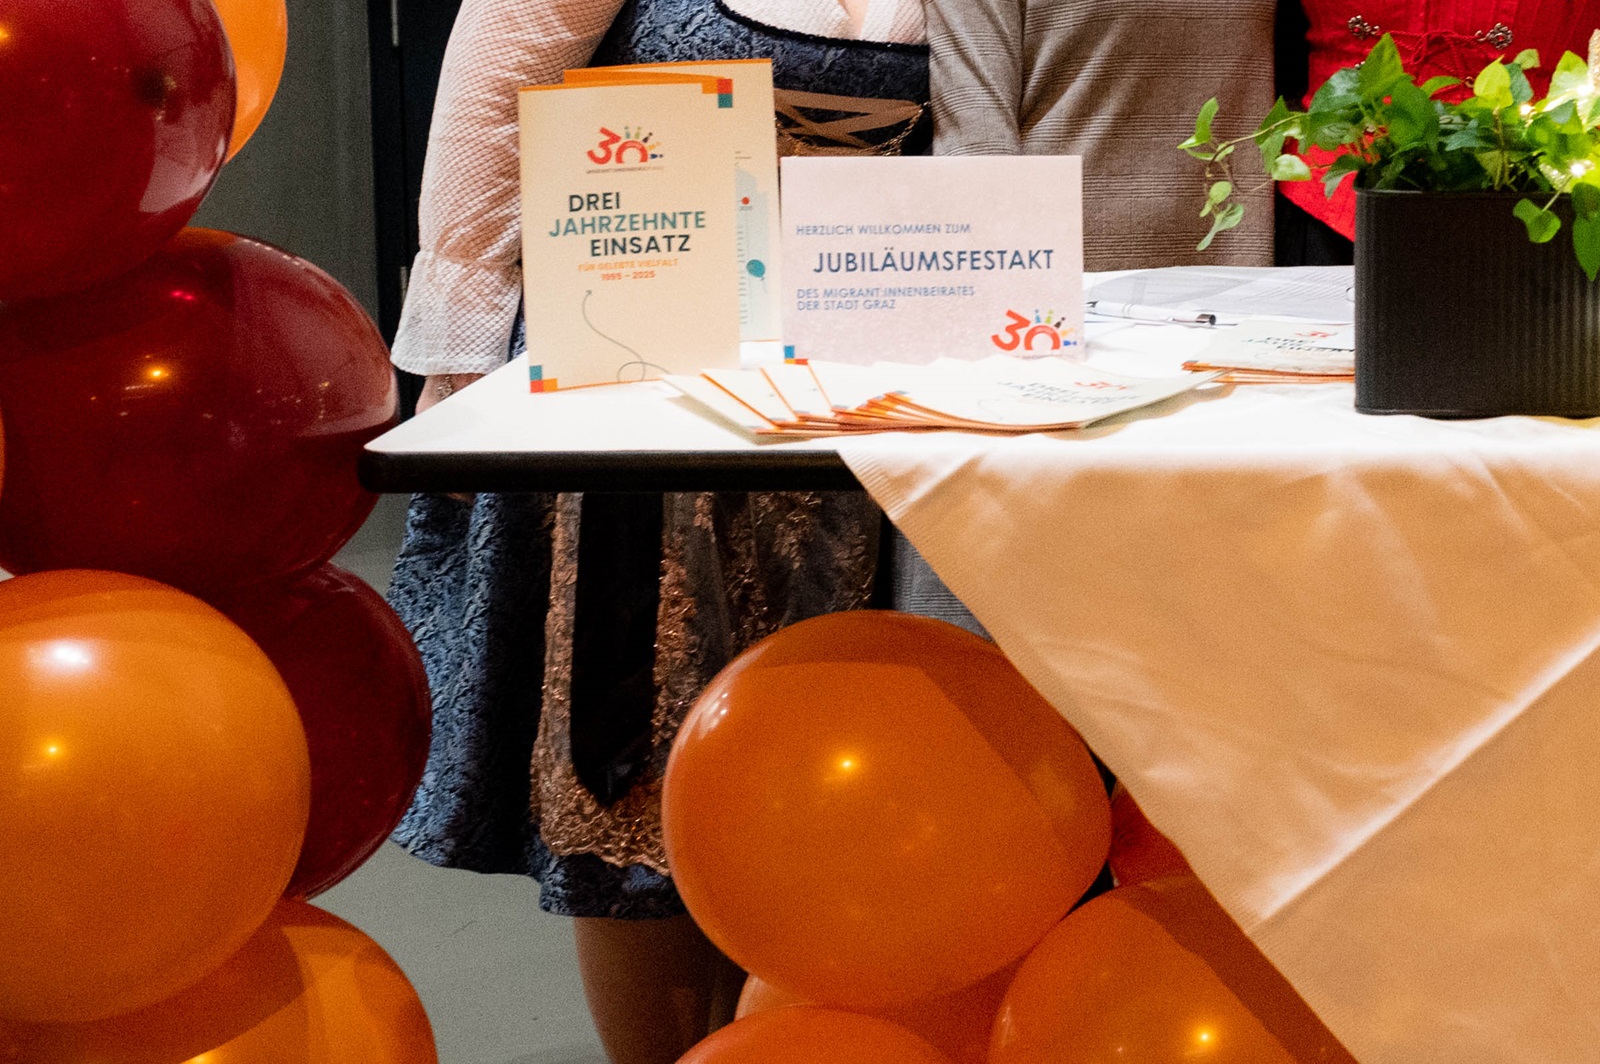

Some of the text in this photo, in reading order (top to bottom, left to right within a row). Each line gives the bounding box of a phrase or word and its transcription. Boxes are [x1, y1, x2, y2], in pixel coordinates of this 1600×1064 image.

[568, 192, 621, 212] DREI
[548, 210, 706, 237] JAHRZEHNTE
[796, 223, 971, 236] HERZLICH WILLKOMMEN ZUM
[590, 234, 692, 257] EINSATZ
[813, 246, 1054, 273] JUBILÄUMSFESTAKT
[796, 288, 820, 299] DES
[796, 299, 897, 311] DER STADT GRAZ
